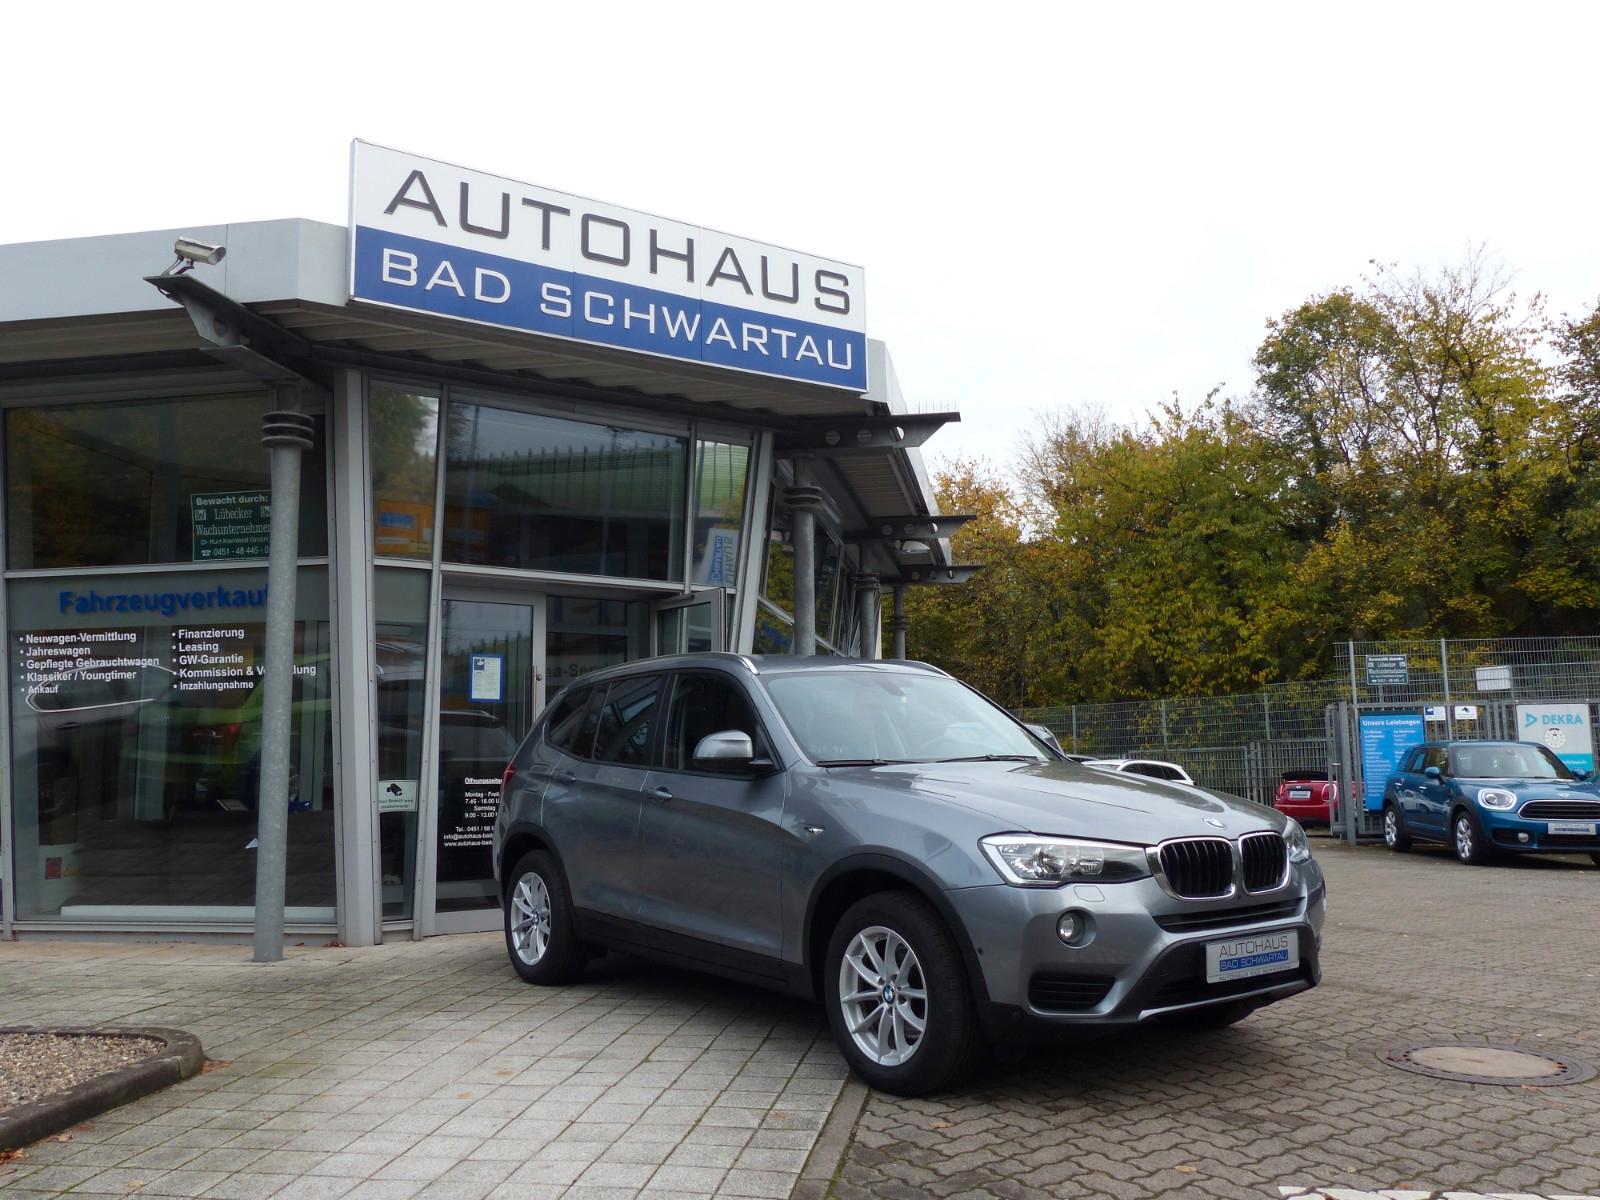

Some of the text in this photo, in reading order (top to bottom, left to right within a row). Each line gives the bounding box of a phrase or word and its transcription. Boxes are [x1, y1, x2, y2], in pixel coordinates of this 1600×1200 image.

[383, 169, 851, 315] AUTOHAUS
[382, 247, 852, 370] BAD SCHWARTAU
[195, 496, 236, 506] Bewacht
[214, 508, 252, 520] Lübecker
[213, 547, 230, 556] 0451
[26, 632, 137, 645] Neuwagen-Vermittlung
[178, 628, 245, 639] Finanzierung
[26, 646, 91, 657] Jahreswagen
[178, 641, 219, 653] Leasing
[26, 657, 160, 671] Gepflegte Gebrauchtwagen
[179, 654, 244, 665] GW-Garantie
[27, 670, 137, 682] Klassiker / Youngtimer
[179, 667, 243, 678] Kommission
[246, 667, 254, 676] &
[27, 684, 59, 694] Ankauf
[180, 681, 254, 691] Inzahlungnahme
[1542, 714, 1584, 725] DEKRA
[1219, 936, 1288, 958] AUTOHAUS
[1221, 951, 1288, 970] BAD SCHWARTAU
